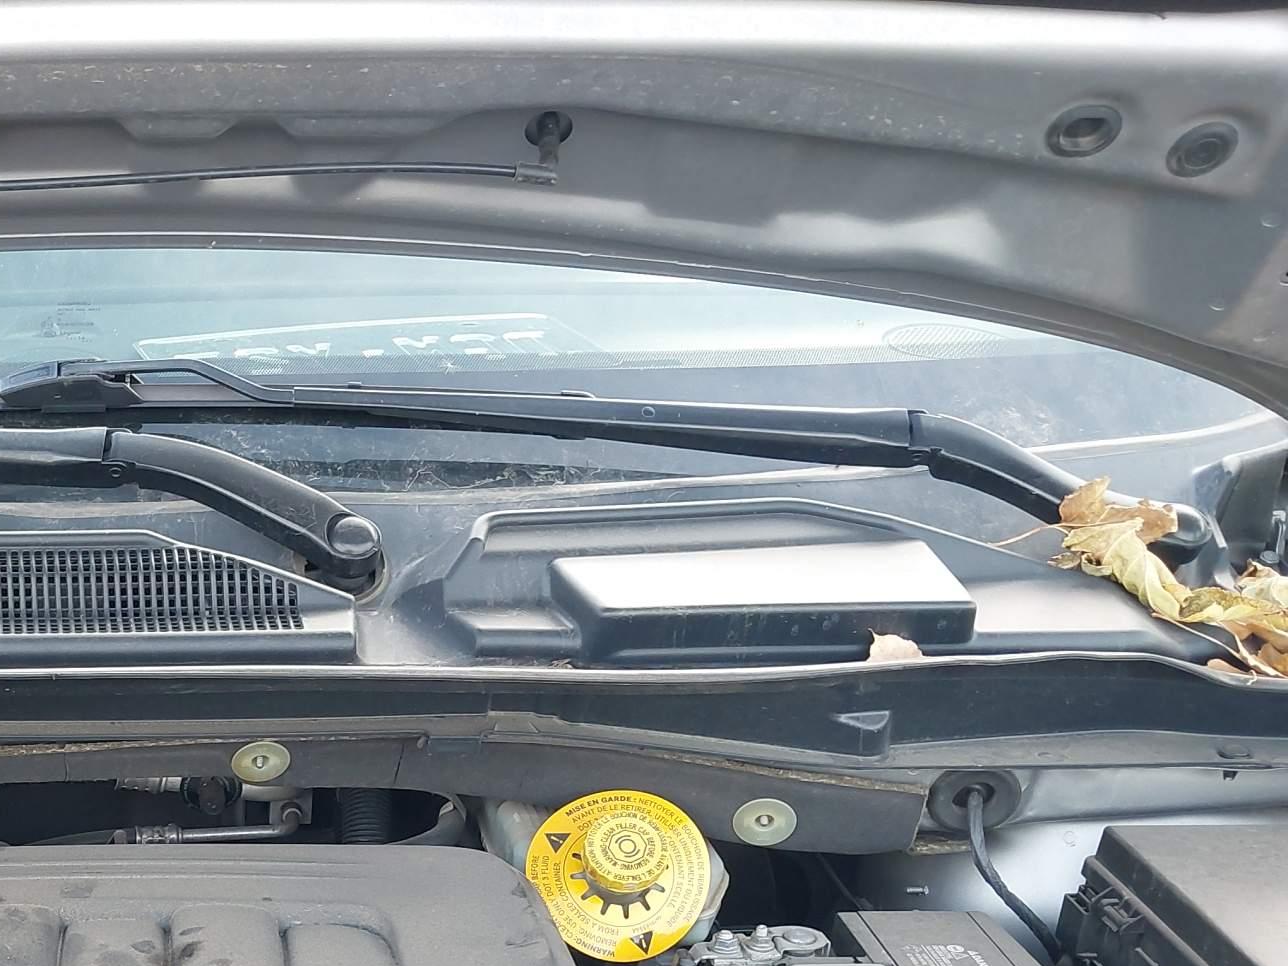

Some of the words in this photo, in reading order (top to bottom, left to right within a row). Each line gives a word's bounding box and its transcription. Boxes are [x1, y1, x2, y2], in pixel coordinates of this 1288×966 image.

[564, 804, 581, 817] MISE
[585, 798, 599, 807] EN
[637, 797, 676, 819] NETTOYER
[673, 815, 684, 826] LE
[570, 807, 596, 824] AVANT
[596, 804, 607, 813] DE
[653, 812, 683, 838] UTILISER
[577, 819, 592, 832] DOT
[530, 853, 541, 880] BEFORE
[539, 854, 551, 874] FLUID
[542, 881, 554, 897] DOT
[561, 914, 578, 929] USE
[565, 901, 591, 925] SEALED
